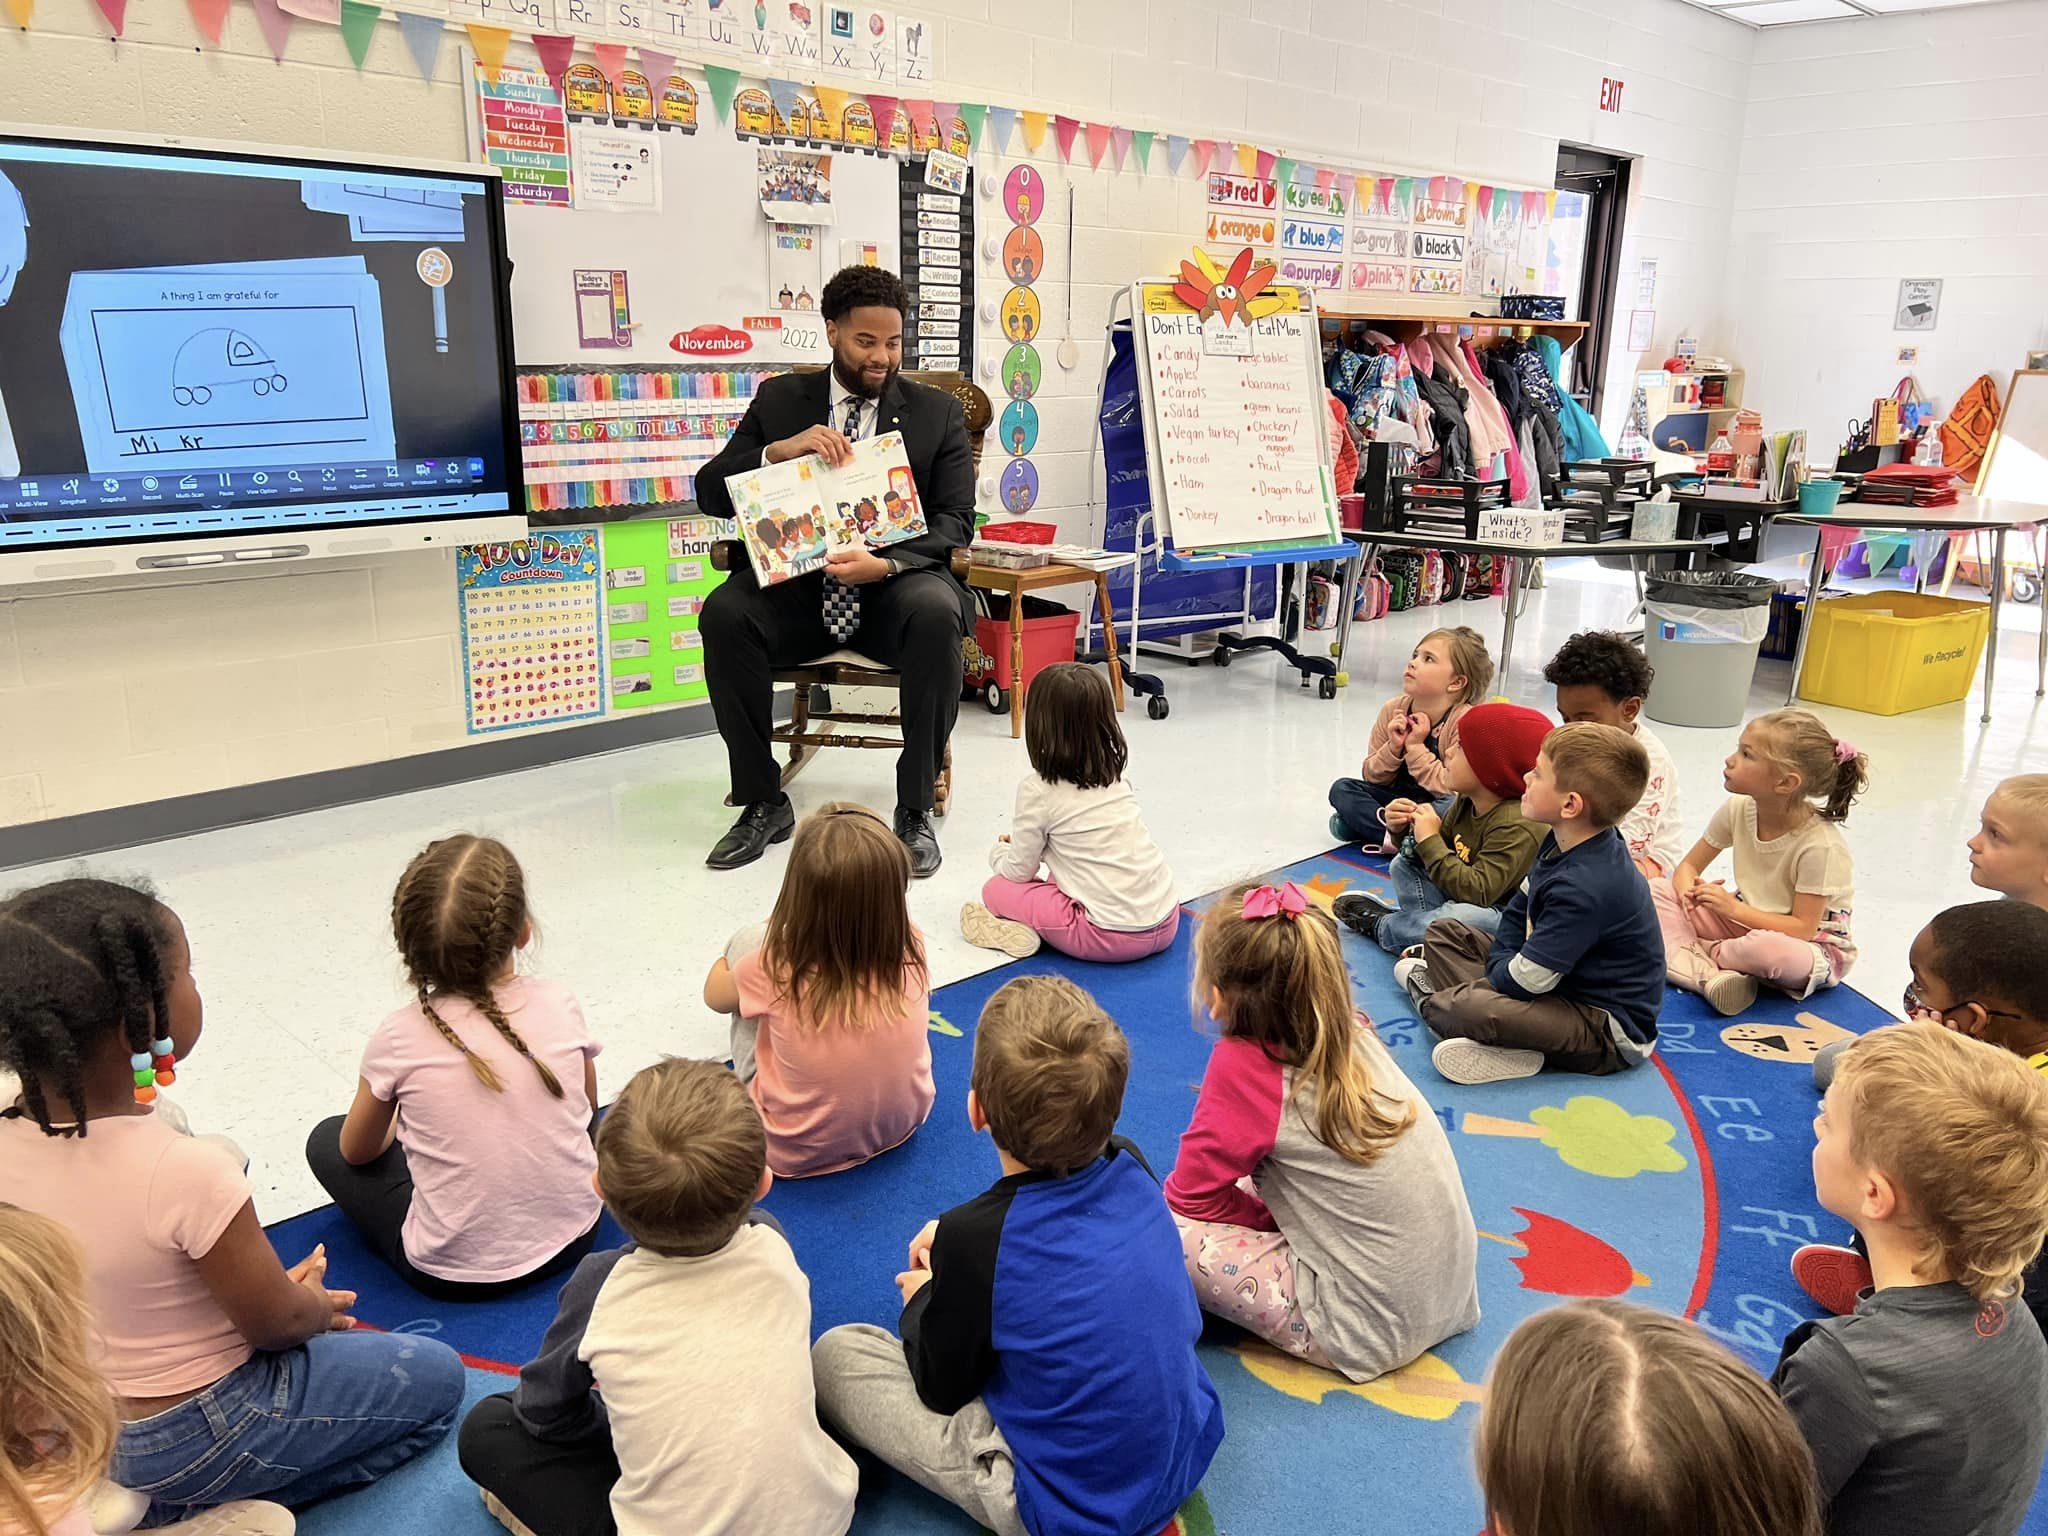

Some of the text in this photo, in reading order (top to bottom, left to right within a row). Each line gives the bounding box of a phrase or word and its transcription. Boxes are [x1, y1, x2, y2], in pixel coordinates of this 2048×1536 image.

[510, 0, 544, 27] Qq
[570, 0, 592, 24] Rr
[619, 5, 641, 28] Ss
[666, 13, 687, 36] Tt
[710, 20, 732, 44] Uu
[752, 34, 770, 55] Vv
[785, 35, 817, 59] Ww
[832, 46, 851, 68] Xx
[870, 52, 885, 80] Yy
[906, 60, 923, 80] Zz
[504, 84, 541, 102] Sunday
[1600, 78, 1624, 113] EXIT
[505, 102, 544, 118] Monday
[505, 118, 546, 136] Tuesday
[499, 134, 554, 151] Wednesday
[505, 151, 551, 168] Thursday
[513, 169, 545, 182] Friday
[1020, 168, 1029, 186] 0
[508, 185, 552, 200] Saturday
[1235, 182, 1258, 202] red
[1426, 204, 1455, 221] brown
[933, 217, 958, 227] Reading
[933, 235, 955, 244] Lunch
[1221, 221, 1260, 242] orange
[1300, 227, 1325, 246] blue
[1368, 233, 1392, 251] gray
[1426, 238, 1451, 255] black
[933, 253, 958, 263] Recess
[932, 272, 957, 282] Writing
[1297, 264, 1330, 284] purple
[1368, 268, 1392, 285] pink
[161, 292, 168, 300] A
[171, 292, 195, 302] thing
[198, 291, 203, 300] I
[224, 290, 261, 301] grateful
[264, 290, 279, 299] for
[932, 289, 959, 297] Calendar
[1018, 288, 1025, 306] 2
[936, 307, 955, 316] Math
[751, 319, 774, 328] FALL
[1152, 316, 1183, 335] Don't
[1187, 316, 1202, 335] Ea
[1257, 317, 1276, 336] Eat
[1277, 317, 1301, 336] More
[679, 334, 747, 350] November
[782, 327, 817, 349] 2022
[933, 342, 954, 352] Snack
[1020, 346, 1026, 362] 3
[1164, 345, 1199, 371] Candy
[930, 359, 958, 368] Centers
[1166, 366, 1197, 384] Apples
[1247, 373, 1290, 390] bananas
[1168, 387, 1206, 399] Carrots
[1016, 402, 1024, 419] 4
[1169, 403, 1199, 418] Salad
[1248, 403, 1270, 415] green
[524, 426, 533, 438] 2
[539, 426, 548, 438] 3
[555, 425, 564, 438] 4
[569, 427, 577, 439] 5
[584, 424, 592, 437] 6
[597, 424, 605, 437] 7
[610, 424, 618, 436] 8
[625, 423, 632, 435] 9
[637, 424, 649, 435] 10
[652, 422, 662, 434] 11
[665, 421, 677, 432] 12
[677, 421, 690, 433] 13
[701, 421, 714, 433] 15
[715, 421, 726, 433] 16
[1172, 425, 1240, 446] Vegan turkey
[130, 434, 203, 454] Mi Kr
[1016, 461, 1023, 477] 5
[1257, 454, 1281, 472] fruit
[1180, 474, 1204, 490] Ham
[1260, 481, 1315, 500] Dragon fruit
[1185, 507, 1218, 525] Donkey
[1265, 510, 1295, 526] Dragon
[1490, 514, 1527, 526] What's
[670, 520, 736, 539] HELPING
[1480, 526, 1532, 542] Inside?
[541, 535, 584, 565] Day
[500, 568, 564, 582] Countdown
[1923, 646, 1967, 664] We Recycle!
[1699, 1094, 1774, 1143] Ee
[1731, 1205, 1821, 1247] Ff
